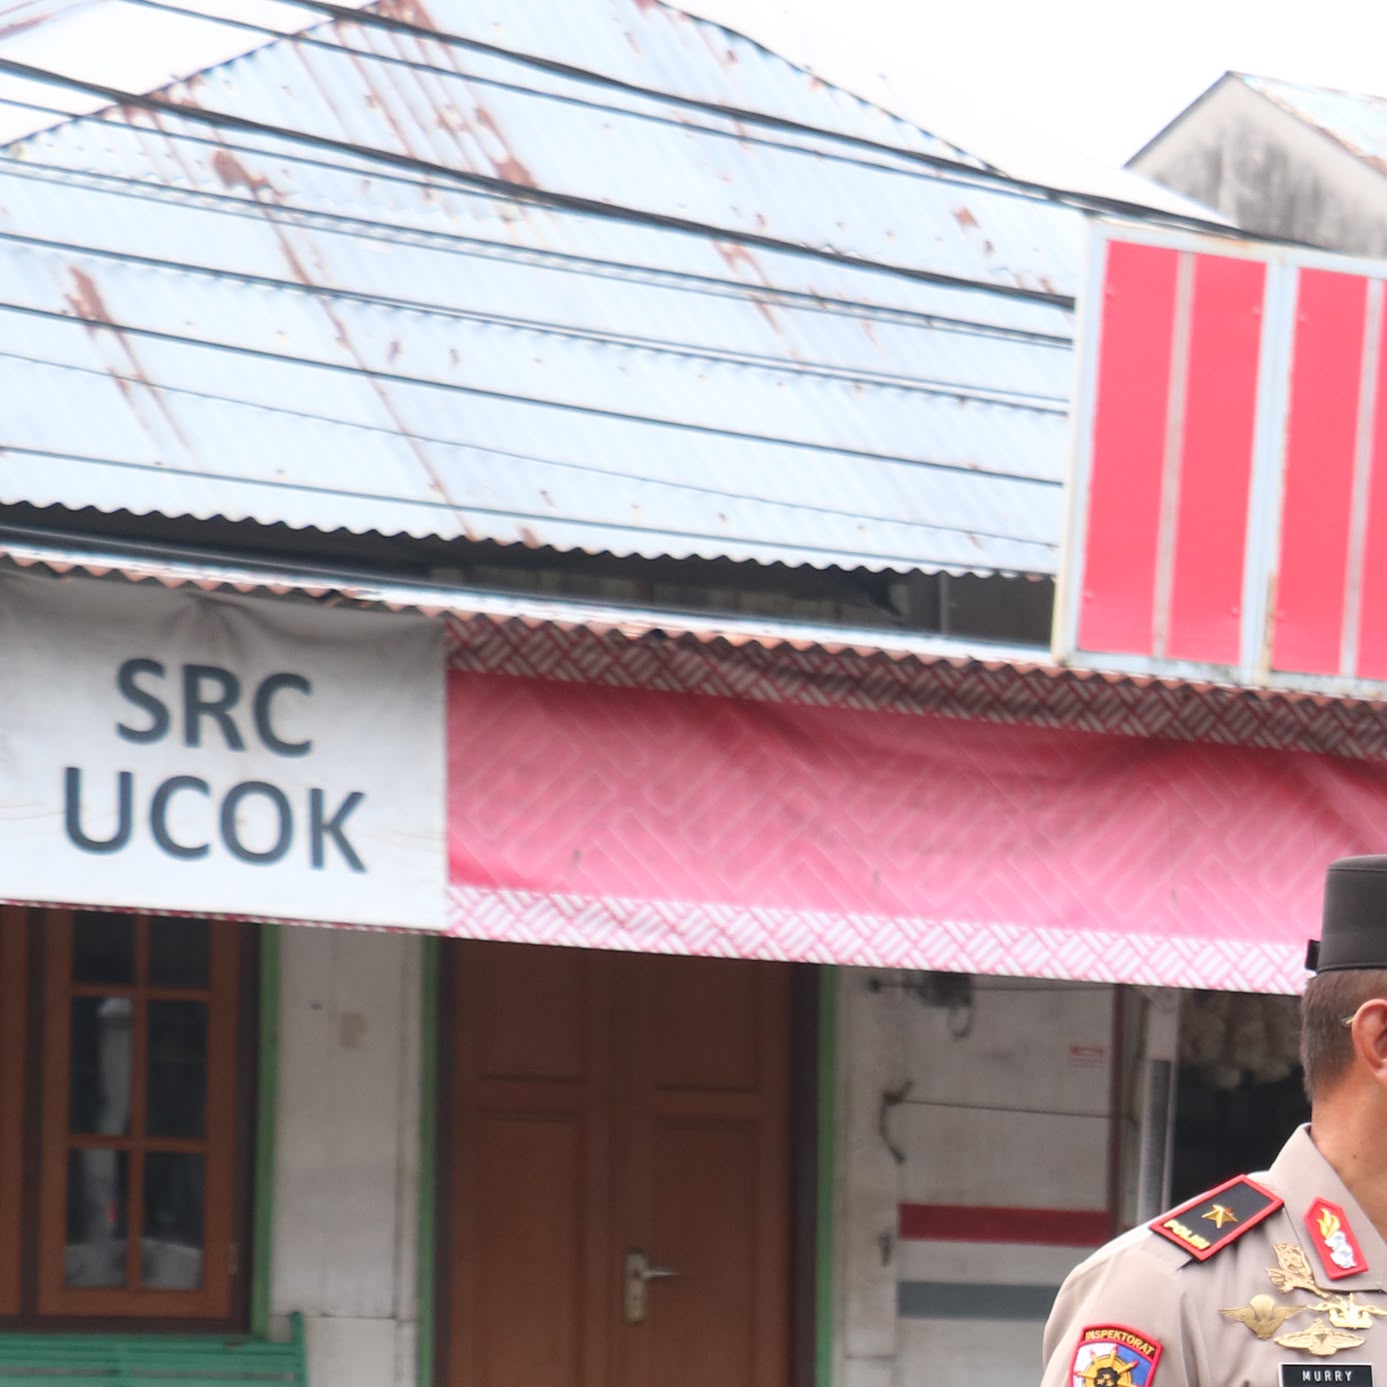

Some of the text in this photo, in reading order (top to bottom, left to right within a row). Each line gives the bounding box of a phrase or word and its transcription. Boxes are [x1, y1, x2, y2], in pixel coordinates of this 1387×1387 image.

[116, 657, 313, 758] SRC
[65, 766, 367, 874] UCOK
[1085, 1329, 1155, 1355] INSPEKTORAT
[1302, 1370, 1353, 1382] MURRY
